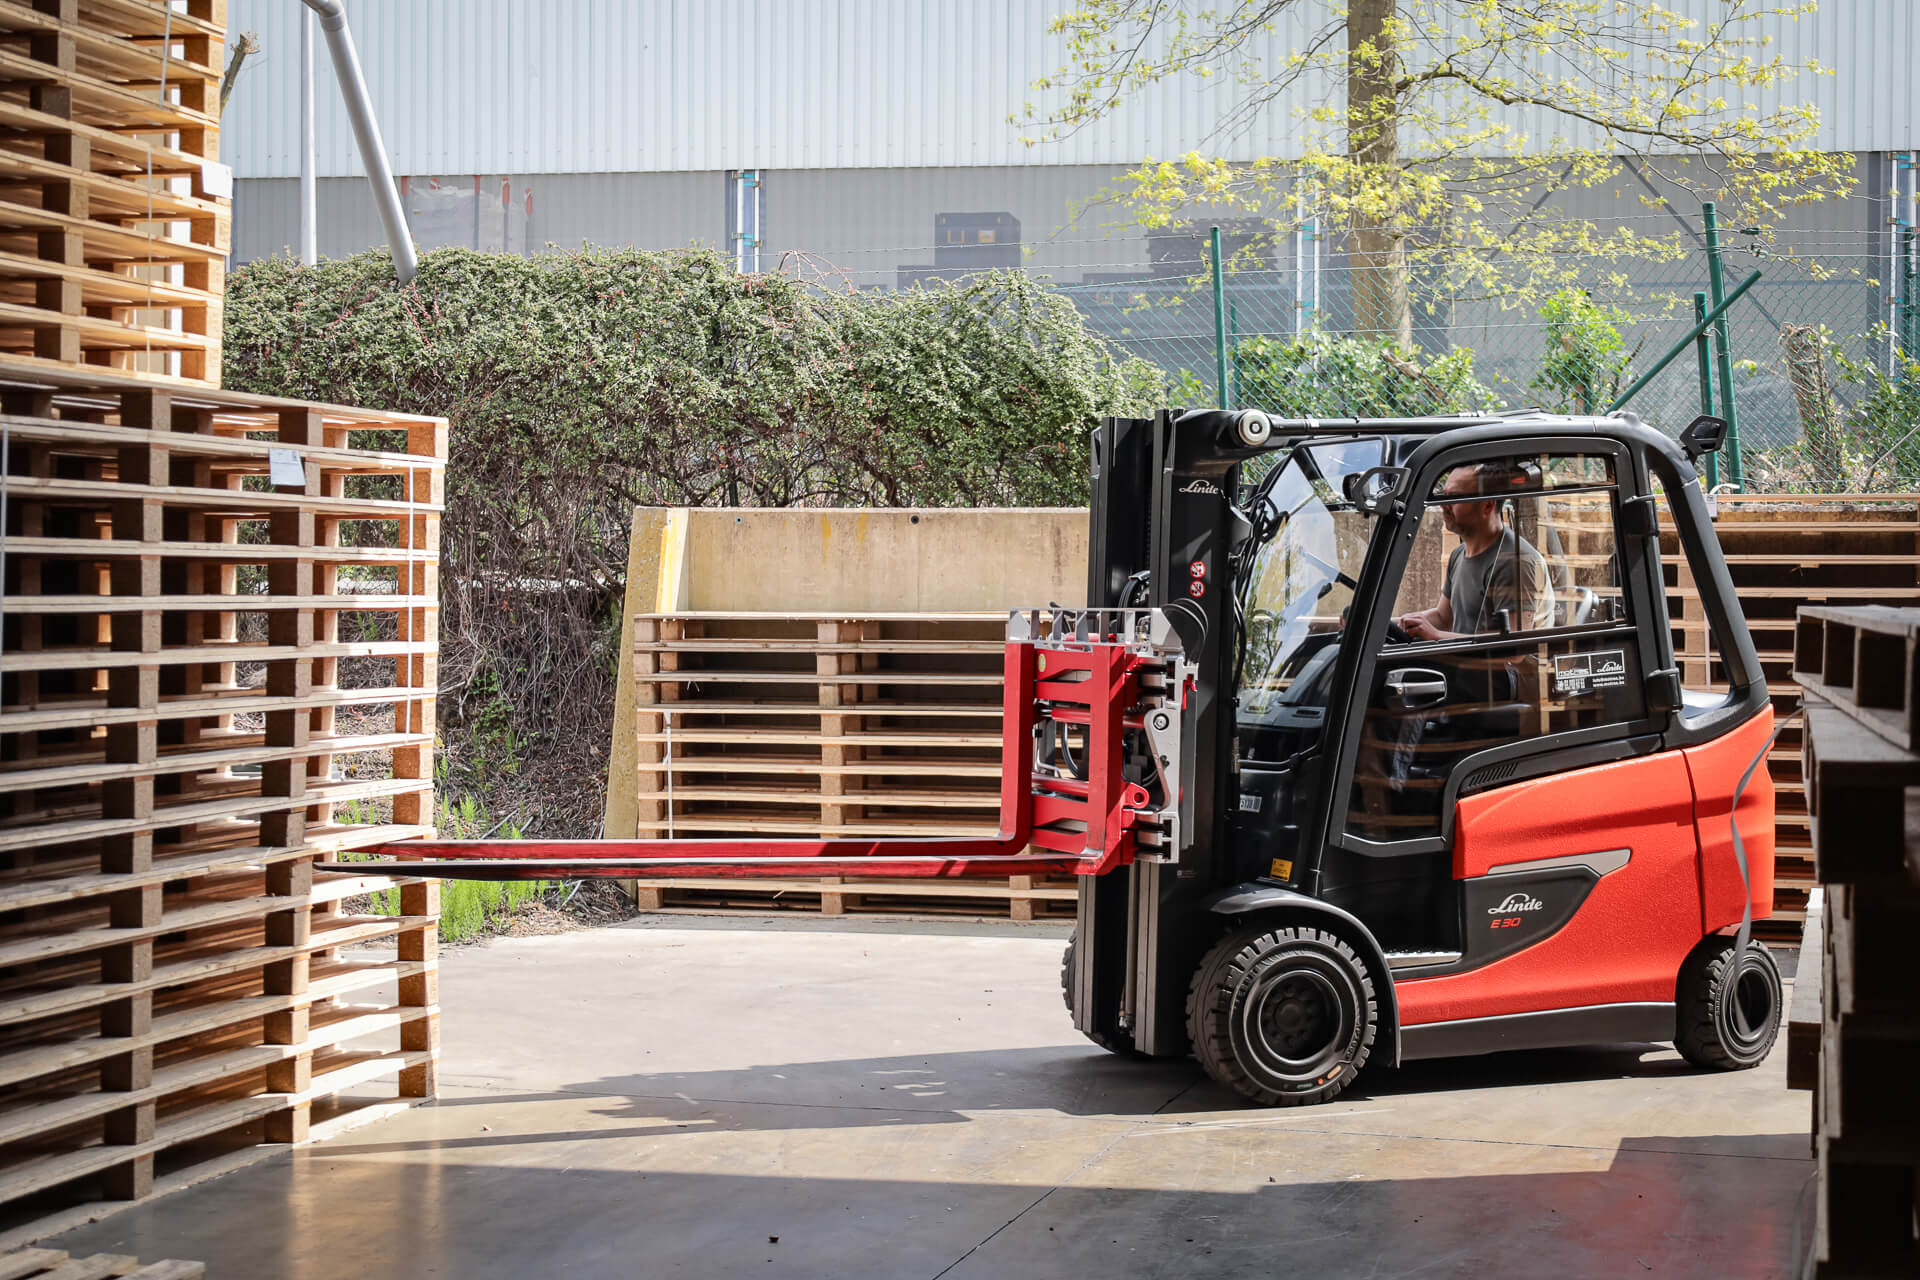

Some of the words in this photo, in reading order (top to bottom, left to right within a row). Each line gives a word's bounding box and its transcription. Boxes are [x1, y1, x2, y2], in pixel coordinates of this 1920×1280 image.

[1179, 479, 1219, 495] Linde
[1596, 661, 1623, 673] Linde
[1487, 892, 1543, 914] Linde
